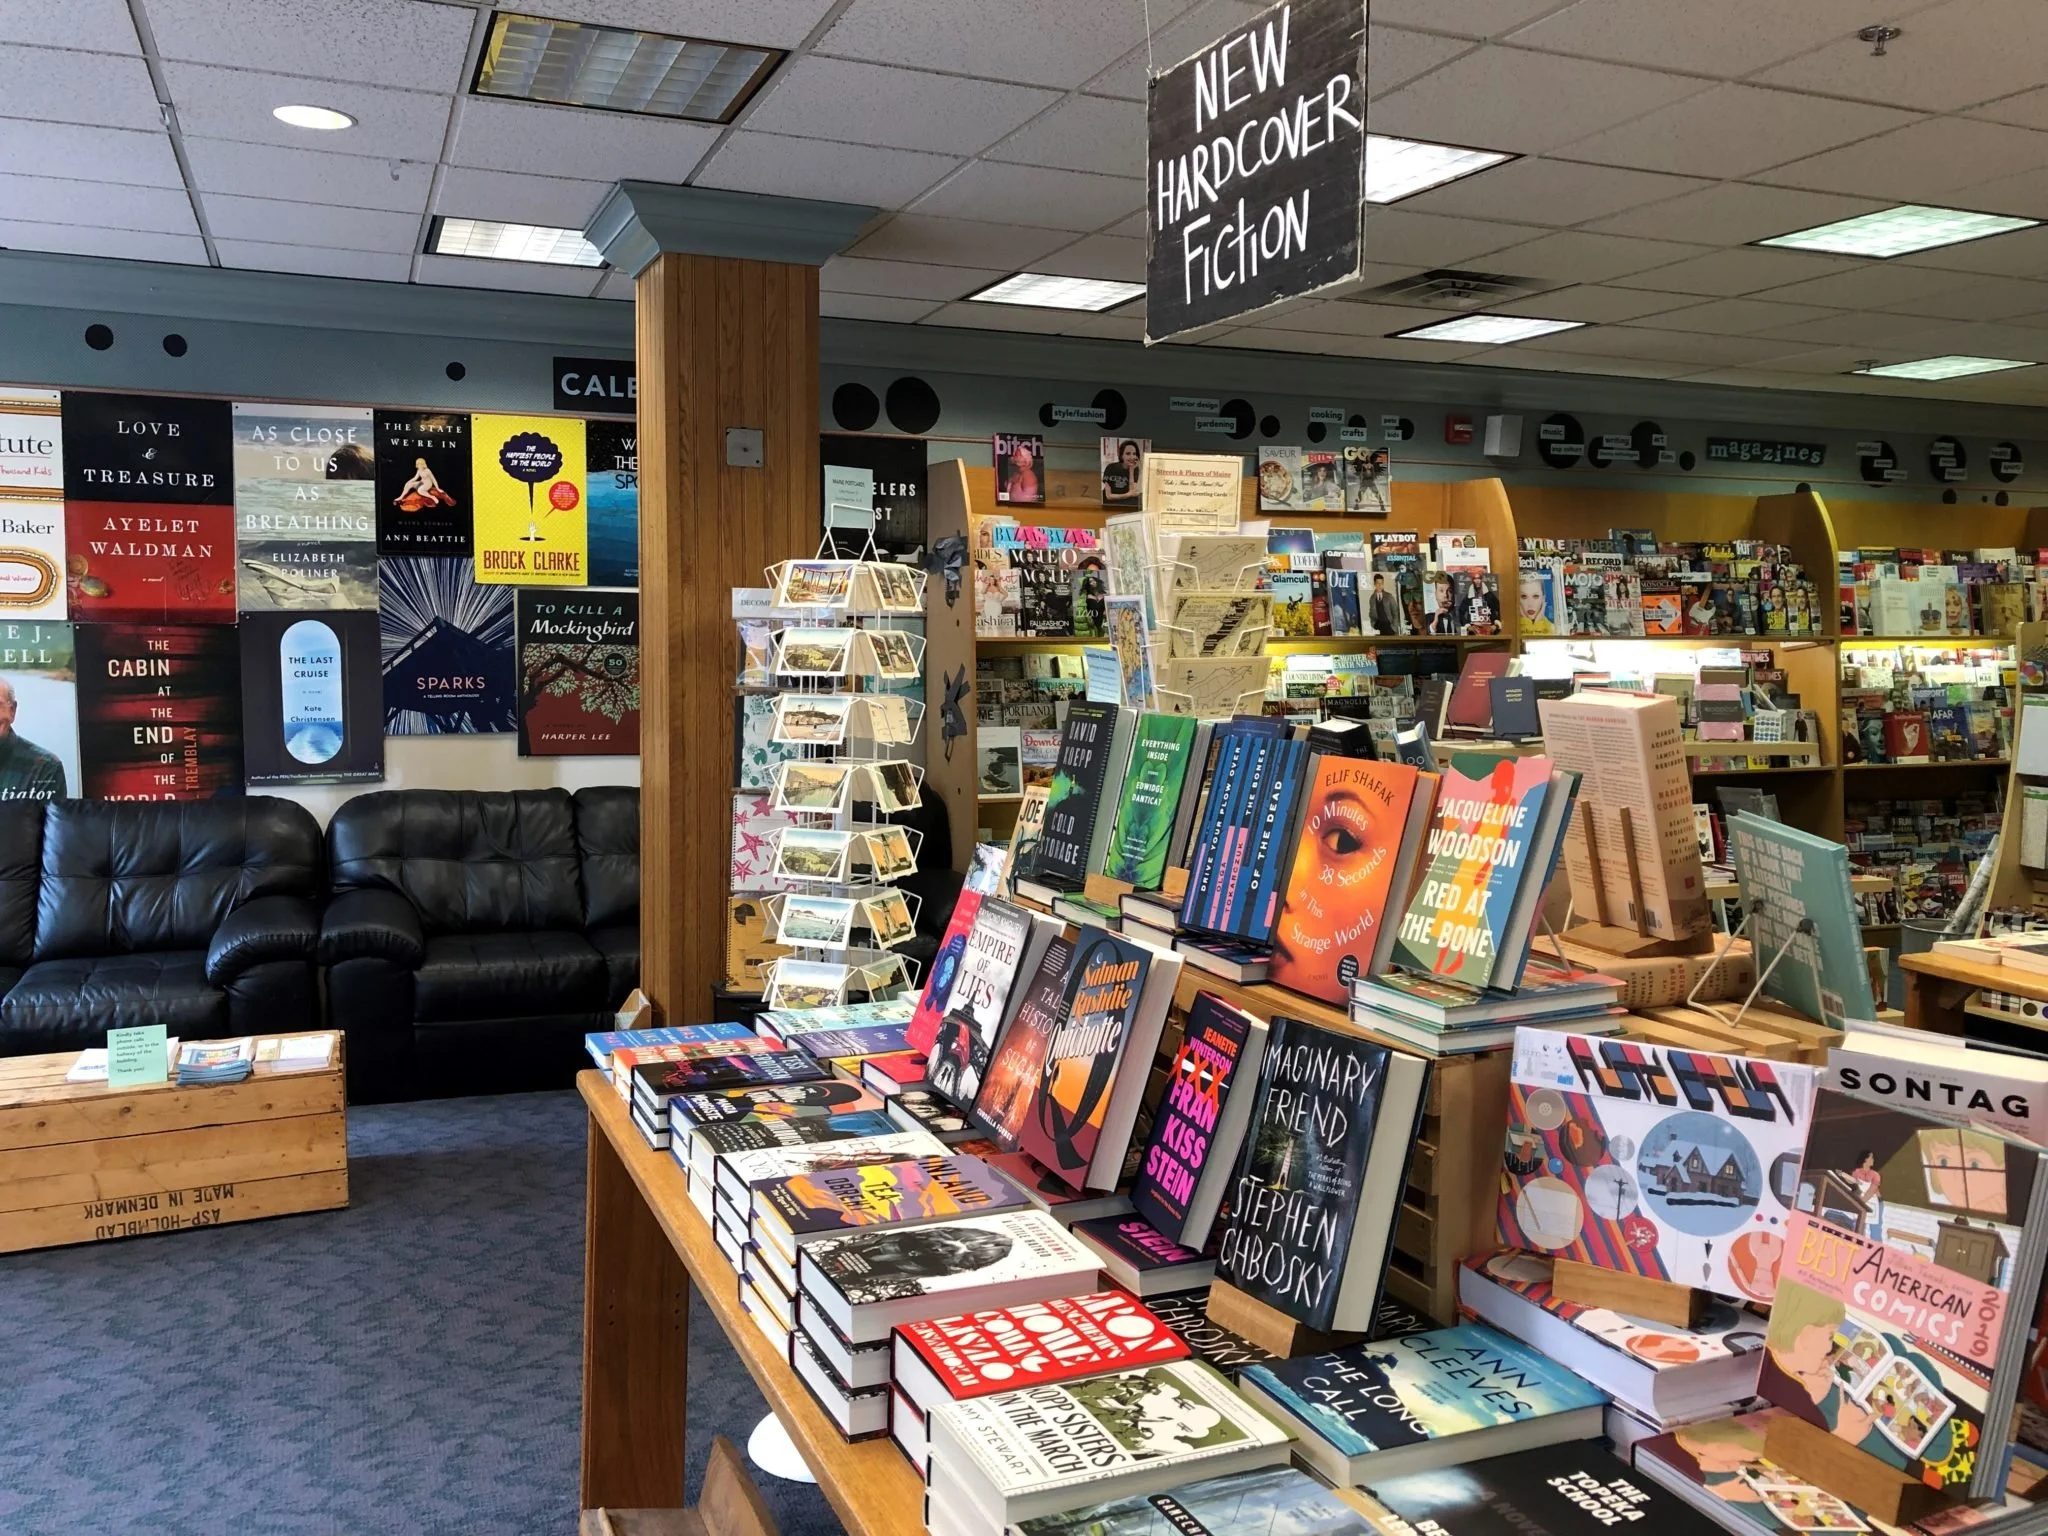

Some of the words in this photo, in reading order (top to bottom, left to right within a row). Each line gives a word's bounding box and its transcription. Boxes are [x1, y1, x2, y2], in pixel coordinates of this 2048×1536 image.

[1195, 5, 1290, 133] NEW
[1158, 73, 1361, 231] HARDCOVER
[1054, 409, 1105, 419] style/fashion
[1311, 410, 1342, 421] cooking
[117, 420, 181, 437] LOVE
[252, 426, 278, 441] AS
[290, 427, 357, 444] CLOSE
[384, 422, 411, 433] THE
[418, 424, 463, 435] STATE
[1197, 420, 1235, 430] gardening
[1342, 428, 1364, 437] crafts
[1542, 428, 1563, 436] music
[142, 447, 156, 460] &
[390, 438, 433, 449] WE'RE
[441, 440, 457, 449] IN
[995, 435, 1044, 457] bitch
[1264, 448, 1296, 458] SAVEUR
[1710, 440, 1822, 464] magazines
[273, 455, 300, 471] TO
[313, 456, 338, 472] US
[530, 460, 552, 468] WORLD
[533, 453, 556, 461] PEOPLE
[34, 466, 52, 476] Kids
[83, 469, 215, 488] TREASURE
[295, 486, 320, 501] AS
[2, 518, 54, 534] Baker
[103, 517, 200, 534] AYELET
[246, 514, 369, 531] BREATHING
[385, 533, 410, 542] ANN
[415, 534, 467, 543] BEATTIE
[1374, 534, 1416, 543] PLAYBOY
[1524, 538, 1565, 550] WIRE
[90, 541, 213, 558] WALDMAN
[273, 552, 345, 564] ELIZABETH
[483, 550, 526, 570] BROCK
[534, 552, 580, 571] CLARKE
[1586, 557, 1621, 565] RECORD
[281, 568, 339, 578] POLINER
[1272, 575, 1309, 583] Glamcult
[1329, 569, 1350, 588] Out
[1565, 573, 1603, 588] MOJO
[536, 604, 556, 614] TO
[564, 604, 605, 615] KILL
[612, 606, 623, 616] A
[530, 619, 635, 643] Mockingbird
[148, 640, 169, 650] THE
[108, 660, 170, 678] CABIN
[289, 656, 312, 665] THE
[314, 656, 334, 665] LAST
[609, 658, 623, 666] 50
[294, 670, 329, 678] CRUISE
[417, 676, 486, 690] SPARKS
[158, 686, 171, 697] AT
[151, 708, 173, 718] THE
[290, 715, 336, 723] Christensen
[304, 705, 322, 713] Kate
[1005, 705, 1051, 717] PORTLAND
[1932, 709, 1954, 719] AFAR
[133, 727, 174, 745] END
[541, 733, 586, 742] HARPER
[591, 733, 611, 741] LEE
[1069, 721, 1095, 742] DAVID
[1141, 739, 1180, 752] EVERYTHING
[1147, 751, 1168, 761] INSIDE
[160, 753, 175, 764] OF
[184, 727, 200, 790] TREMBLAY
[1063, 747, 1092, 769] KOEPP
[154, 775, 176, 785] THE
[1136, 781, 1164, 794] EDWIDGE
[1246, 796, 1254, 816] THE
[1252, 748, 1266, 789] BONES
[1325, 769, 1351, 788] ELIF
[1352, 769, 1395, 807] SHAFAK
[1132, 794, 1162, 807] DANTICAT
[1019, 799, 1041, 824] JOE
[1201, 860, 1214, 892] DRIVE
[1211, 820, 1222, 852] YOUR
[1220, 782, 1232, 815] PLOW
[1229, 746, 1241, 777] OVER
[1307, 815, 1321, 836] 10
[1323, 801, 1370, 832] Minutes
[1437, 798, 1528, 828] JACQUELINE
[1051, 812, 1074, 835] COLD
[1251, 869, 1261, 890] OF
[1257, 829, 1272, 863] THE
[1266, 781, 1283, 823] DEAD
[1039, 837, 1080, 866] STORAGE
[1427, 829, 1521, 868] WOODSON
[1216, 861, 1227, 893] OLGA
[1225, 841, 1244, 913] TOKARCZUK
[1319, 864, 1334, 886] 38
[1336, 846, 1387, 887] Seconds
[1306, 899, 1324, 919] This
[1422, 880, 1460, 909] RED
[1463, 890, 1492, 917] AT
[1291, 922, 1331, 954] Strange
[1335, 909, 1375, 947] World
[1401, 913, 1432, 944] THE
[1437, 922, 1493, 958] BONE
[968, 928, 1016, 966] EMPIRE
[977, 957, 991, 974] OF
[1082, 958, 1140, 990] Salman
[1060, 971, 1069, 984] A
[956, 970, 996, 1010] LIES
[1073, 986, 1133, 1024] Rushdie
[1046, 1014, 1122, 1076] Quichotte
[1203, 1027, 1238, 1058] JEANETTE
[779, 1054, 809, 1069] TESS
[1189, 1036, 1233, 1075] WINTERSON
[1261, 1041, 1378, 1106] IMAGINARY
[1839, 1067, 2030, 1119] SONTAG
[1169, 1082, 1219, 1134] FRAN
[1264, 1087, 1348, 1148] FRIEND
[1162, 1114, 1206, 1169] KISS
[918, 1155, 992, 1204] INLAND
[1146, 1145, 1195, 1207] STEIN
[169, 1191, 183, 1207] IN
[194, 1185, 234, 1200] MADE
[824, 1177, 876, 1212] OBREHT
[84, 1195, 159, 1219] DENMARK
[1231, 1174, 1339, 1259] STEPHEN
[95, 1208, 221, 1240] ASP-HOLMBLAD
[1118, 1222, 1195, 1263] STEIN
[1220, 1227, 1333, 1309] CHBOSKY
[1796, 1227, 1861, 1284] BEST
[1853, 1246, 1972, 1319] AMERICAN
[1853, 1281, 1964, 1346] COMICS
[1969, 1290, 2000, 1358] 2019
[1400, 1336, 1533, 1416] CLEEVES
[1456, 1346, 1542, 1391] ANN
[1302, 1376, 1368, 1422] CALL
[1314, 1351, 1360, 1385] THE
[1359, 1386, 1430, 1436] LONG
[957, 1402, 984, 1422] AMY
[977, 1424, 1032, 1477] STEWART
[988, 1391, 1014, 1412] ON
[1006, 1408, 1047, 1429] THE
[1030, 1427, 1089, 1475] MARCH
[1053, 1412, 1127, 1468] SISTERS
[1566, 1470, 1647, 1523] TOPEKA
[1607, 1477, 1651, 1503] THE
[1546, 1476, 1623, 1527] SCHOOL
